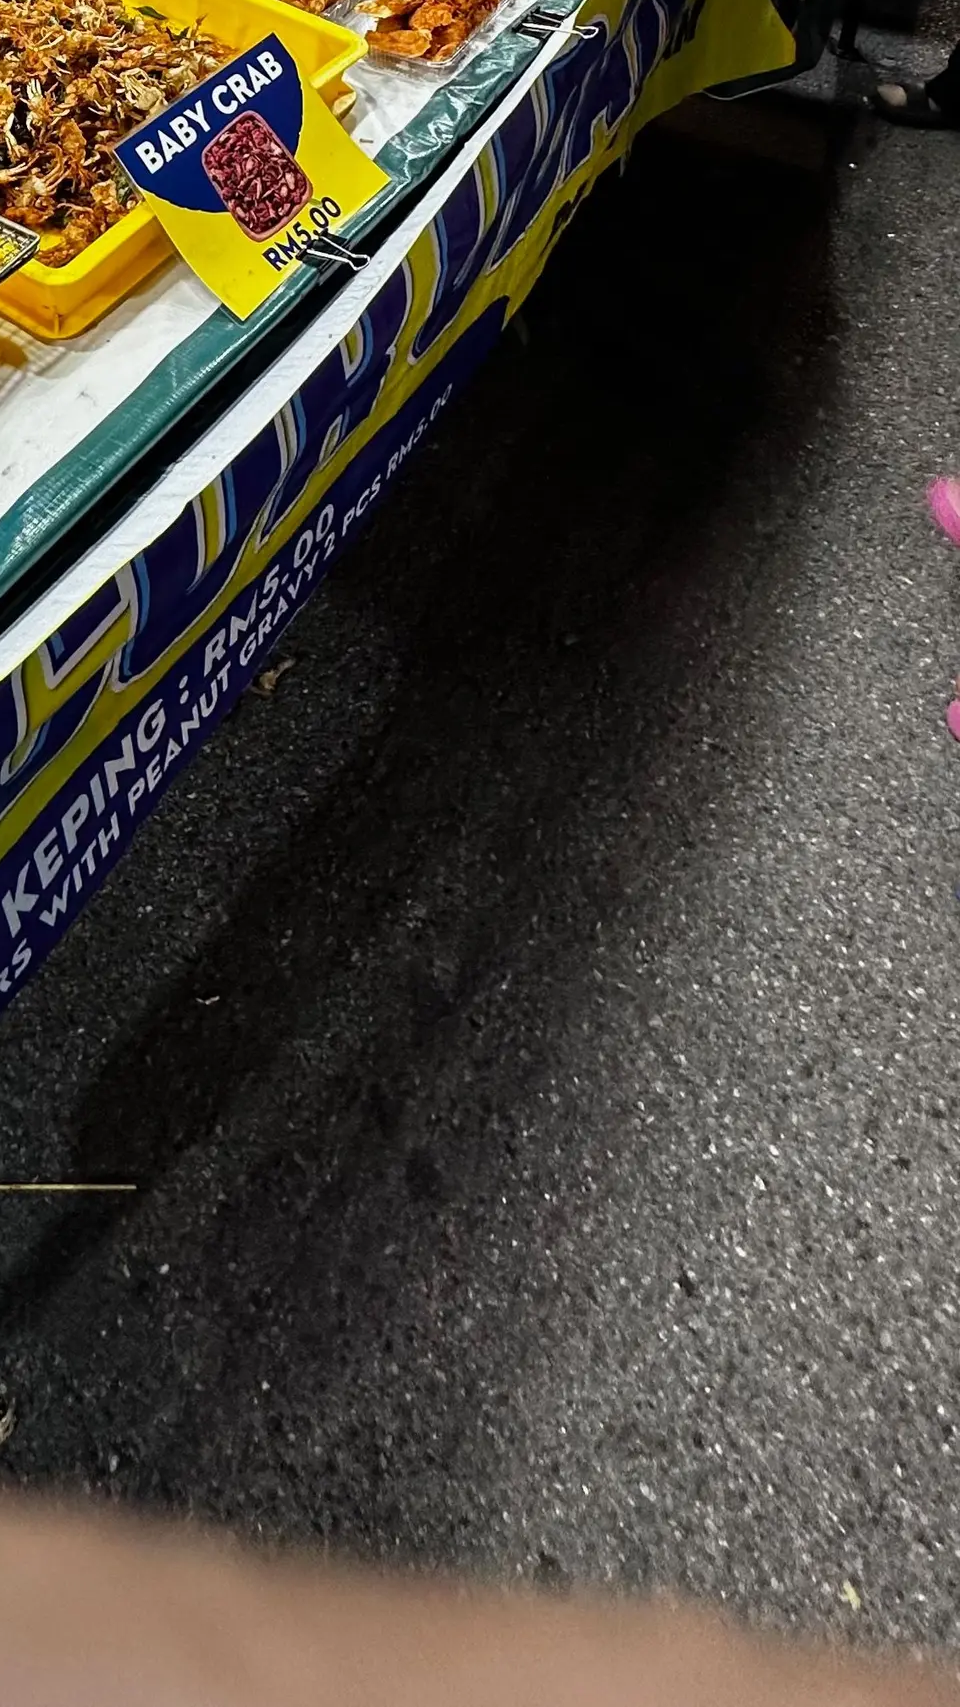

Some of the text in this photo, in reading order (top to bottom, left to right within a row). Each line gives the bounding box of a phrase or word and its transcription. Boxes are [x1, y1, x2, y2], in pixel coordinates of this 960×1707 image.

[134, 50, 284, 175] BABY CRAB
[261, 195, 342, 272] RM5.00
[0, 702, 170, 939] KEPING
[203, 503, 336, 676] RM5.00
[38, 817, 122, 932] WITH
[127, 668, 232, 818] PEANUT
[238, 549, 323, 667] GRAVY
[324, 531, 336, 561] 2
[341, 474, 382, 538] PCS
[385, 382, 454, 481] RM5.00
